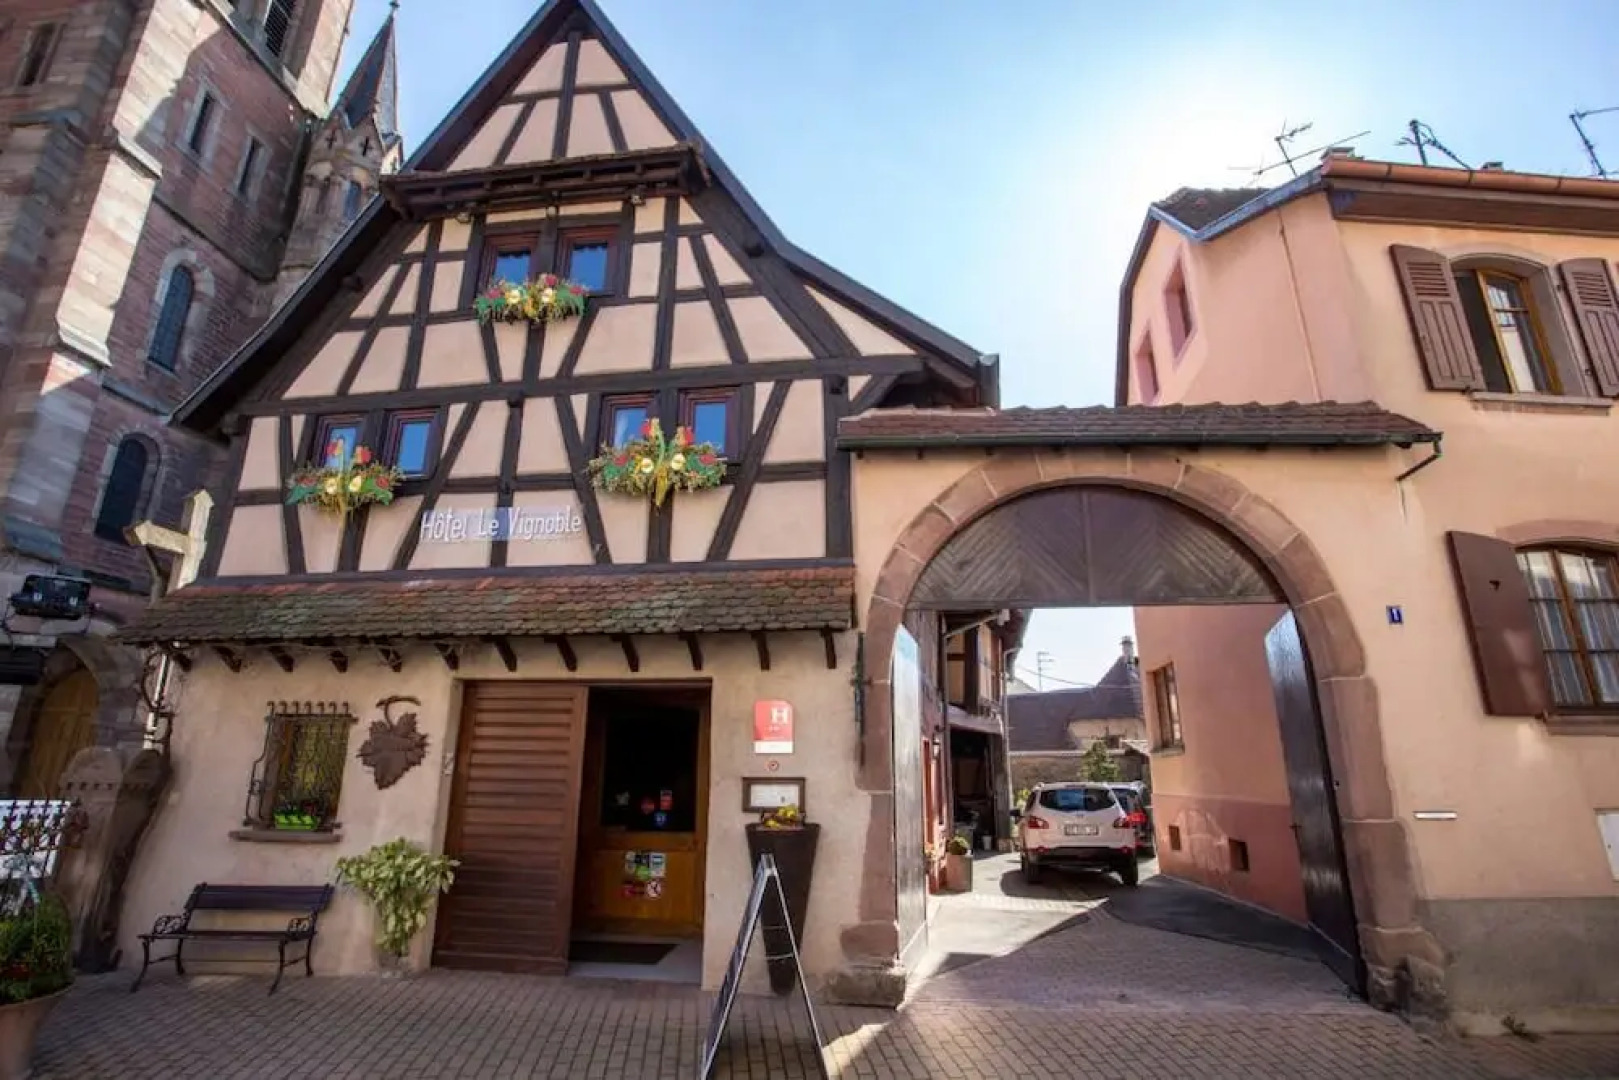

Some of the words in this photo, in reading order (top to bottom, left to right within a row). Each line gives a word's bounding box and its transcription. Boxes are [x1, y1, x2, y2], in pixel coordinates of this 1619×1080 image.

[420, 507, 467, 541] Hôtel
[478, 508, 500, 537] Le
[508, 505, 582, 540] Vignoble
[1392, 608, 1399, 621] 1
[771, 707, 789, 724] H
